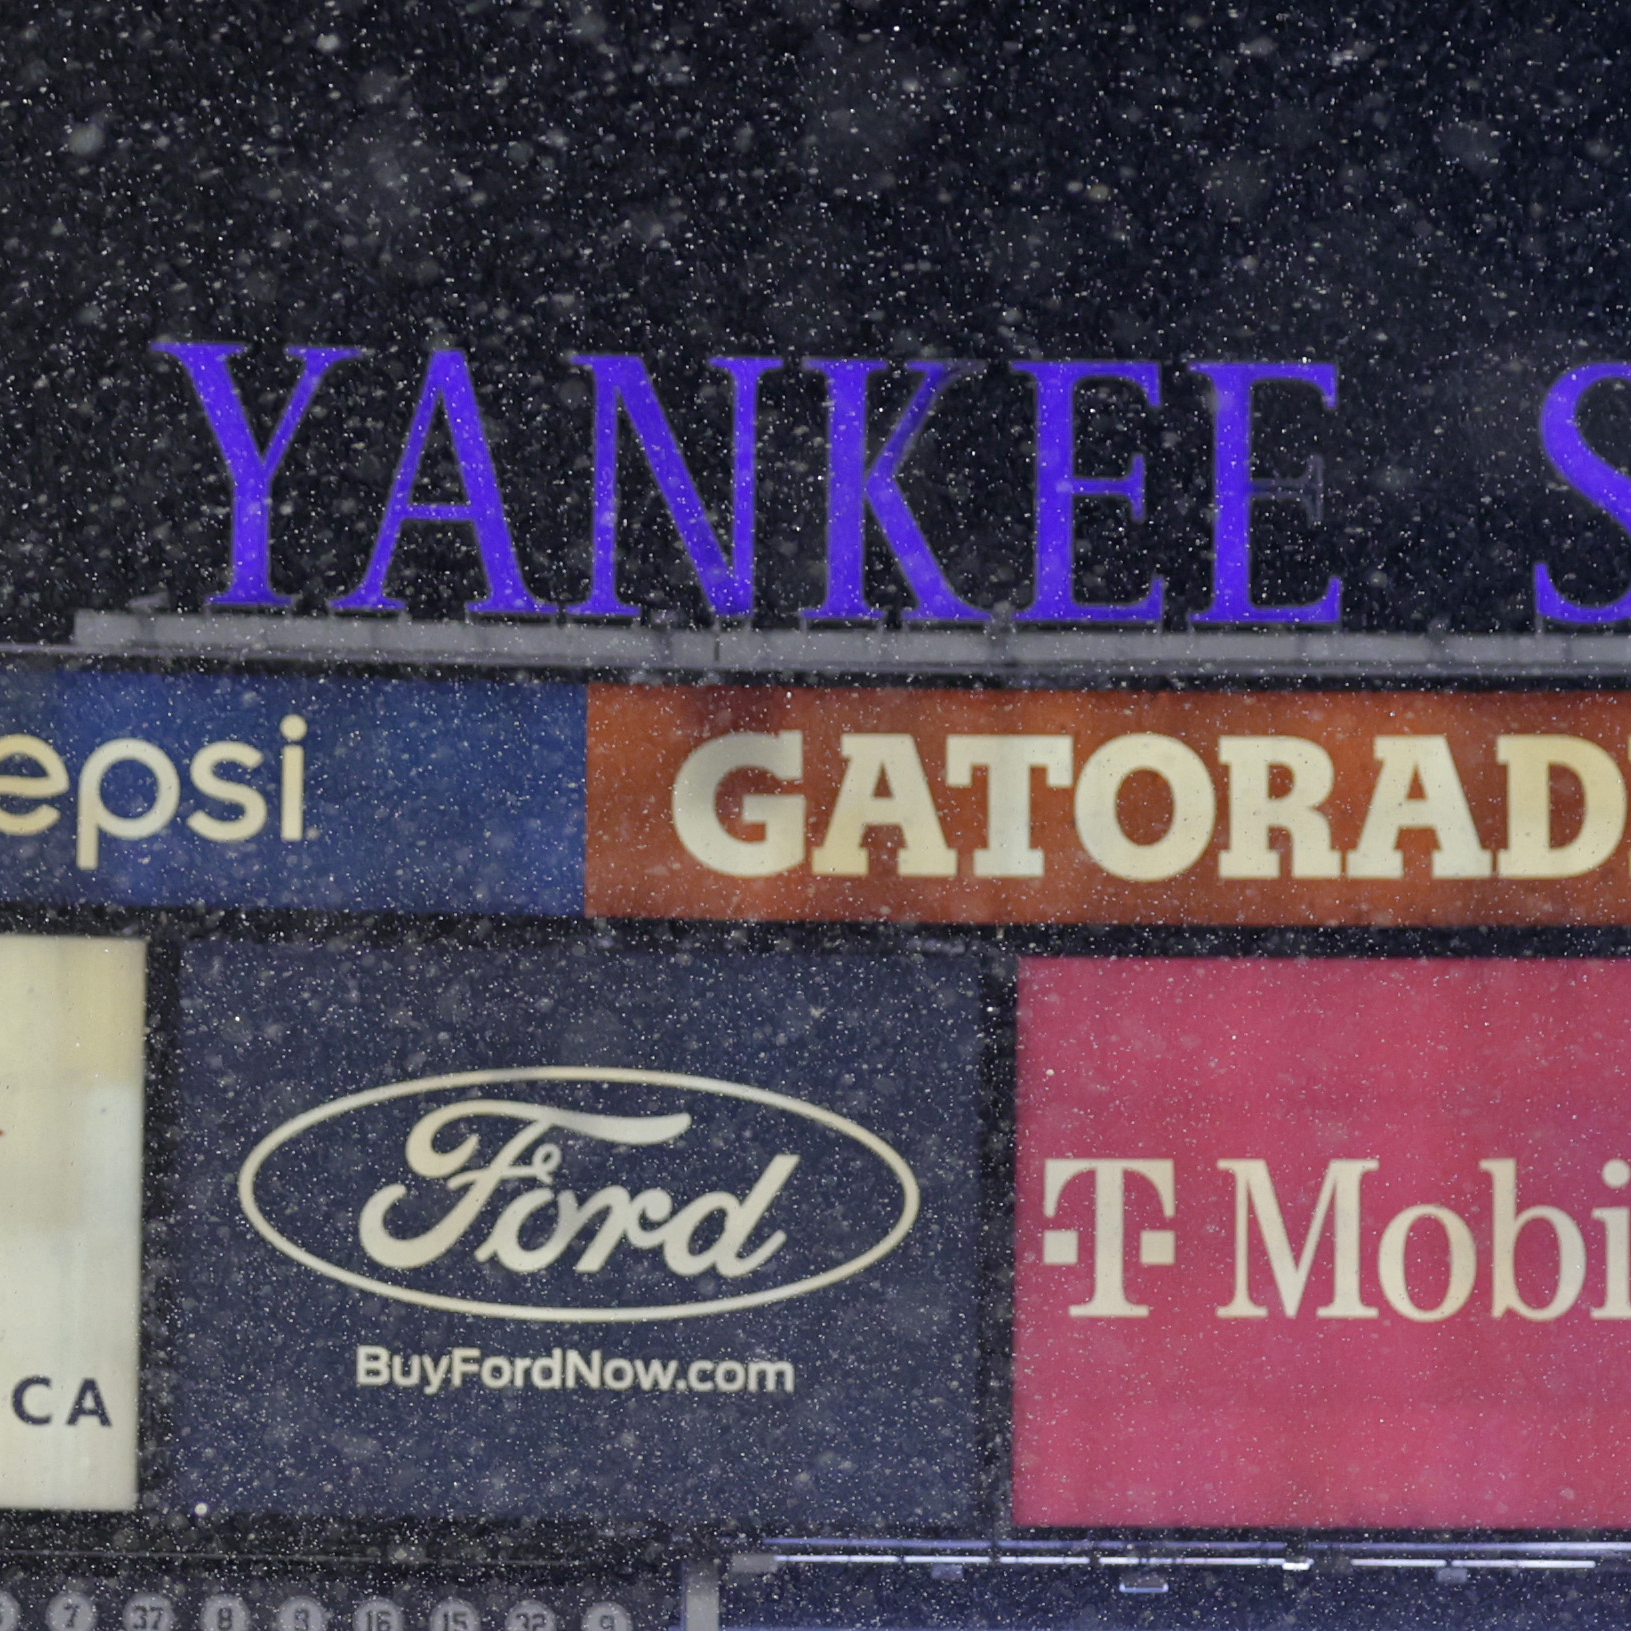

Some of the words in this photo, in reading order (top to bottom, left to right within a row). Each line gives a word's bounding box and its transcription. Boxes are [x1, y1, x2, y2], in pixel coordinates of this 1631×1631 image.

[151, 340, 1343, 625] YANKEE
[359, 1099, 800, 1278] Ford
[356, 1345, 794, 1395] BuyFordNow.com
[63, 1604, 78, 1628] 7
[133, 1605, 165, 1630] 37
[217, 1607, 234, 1631] 8
